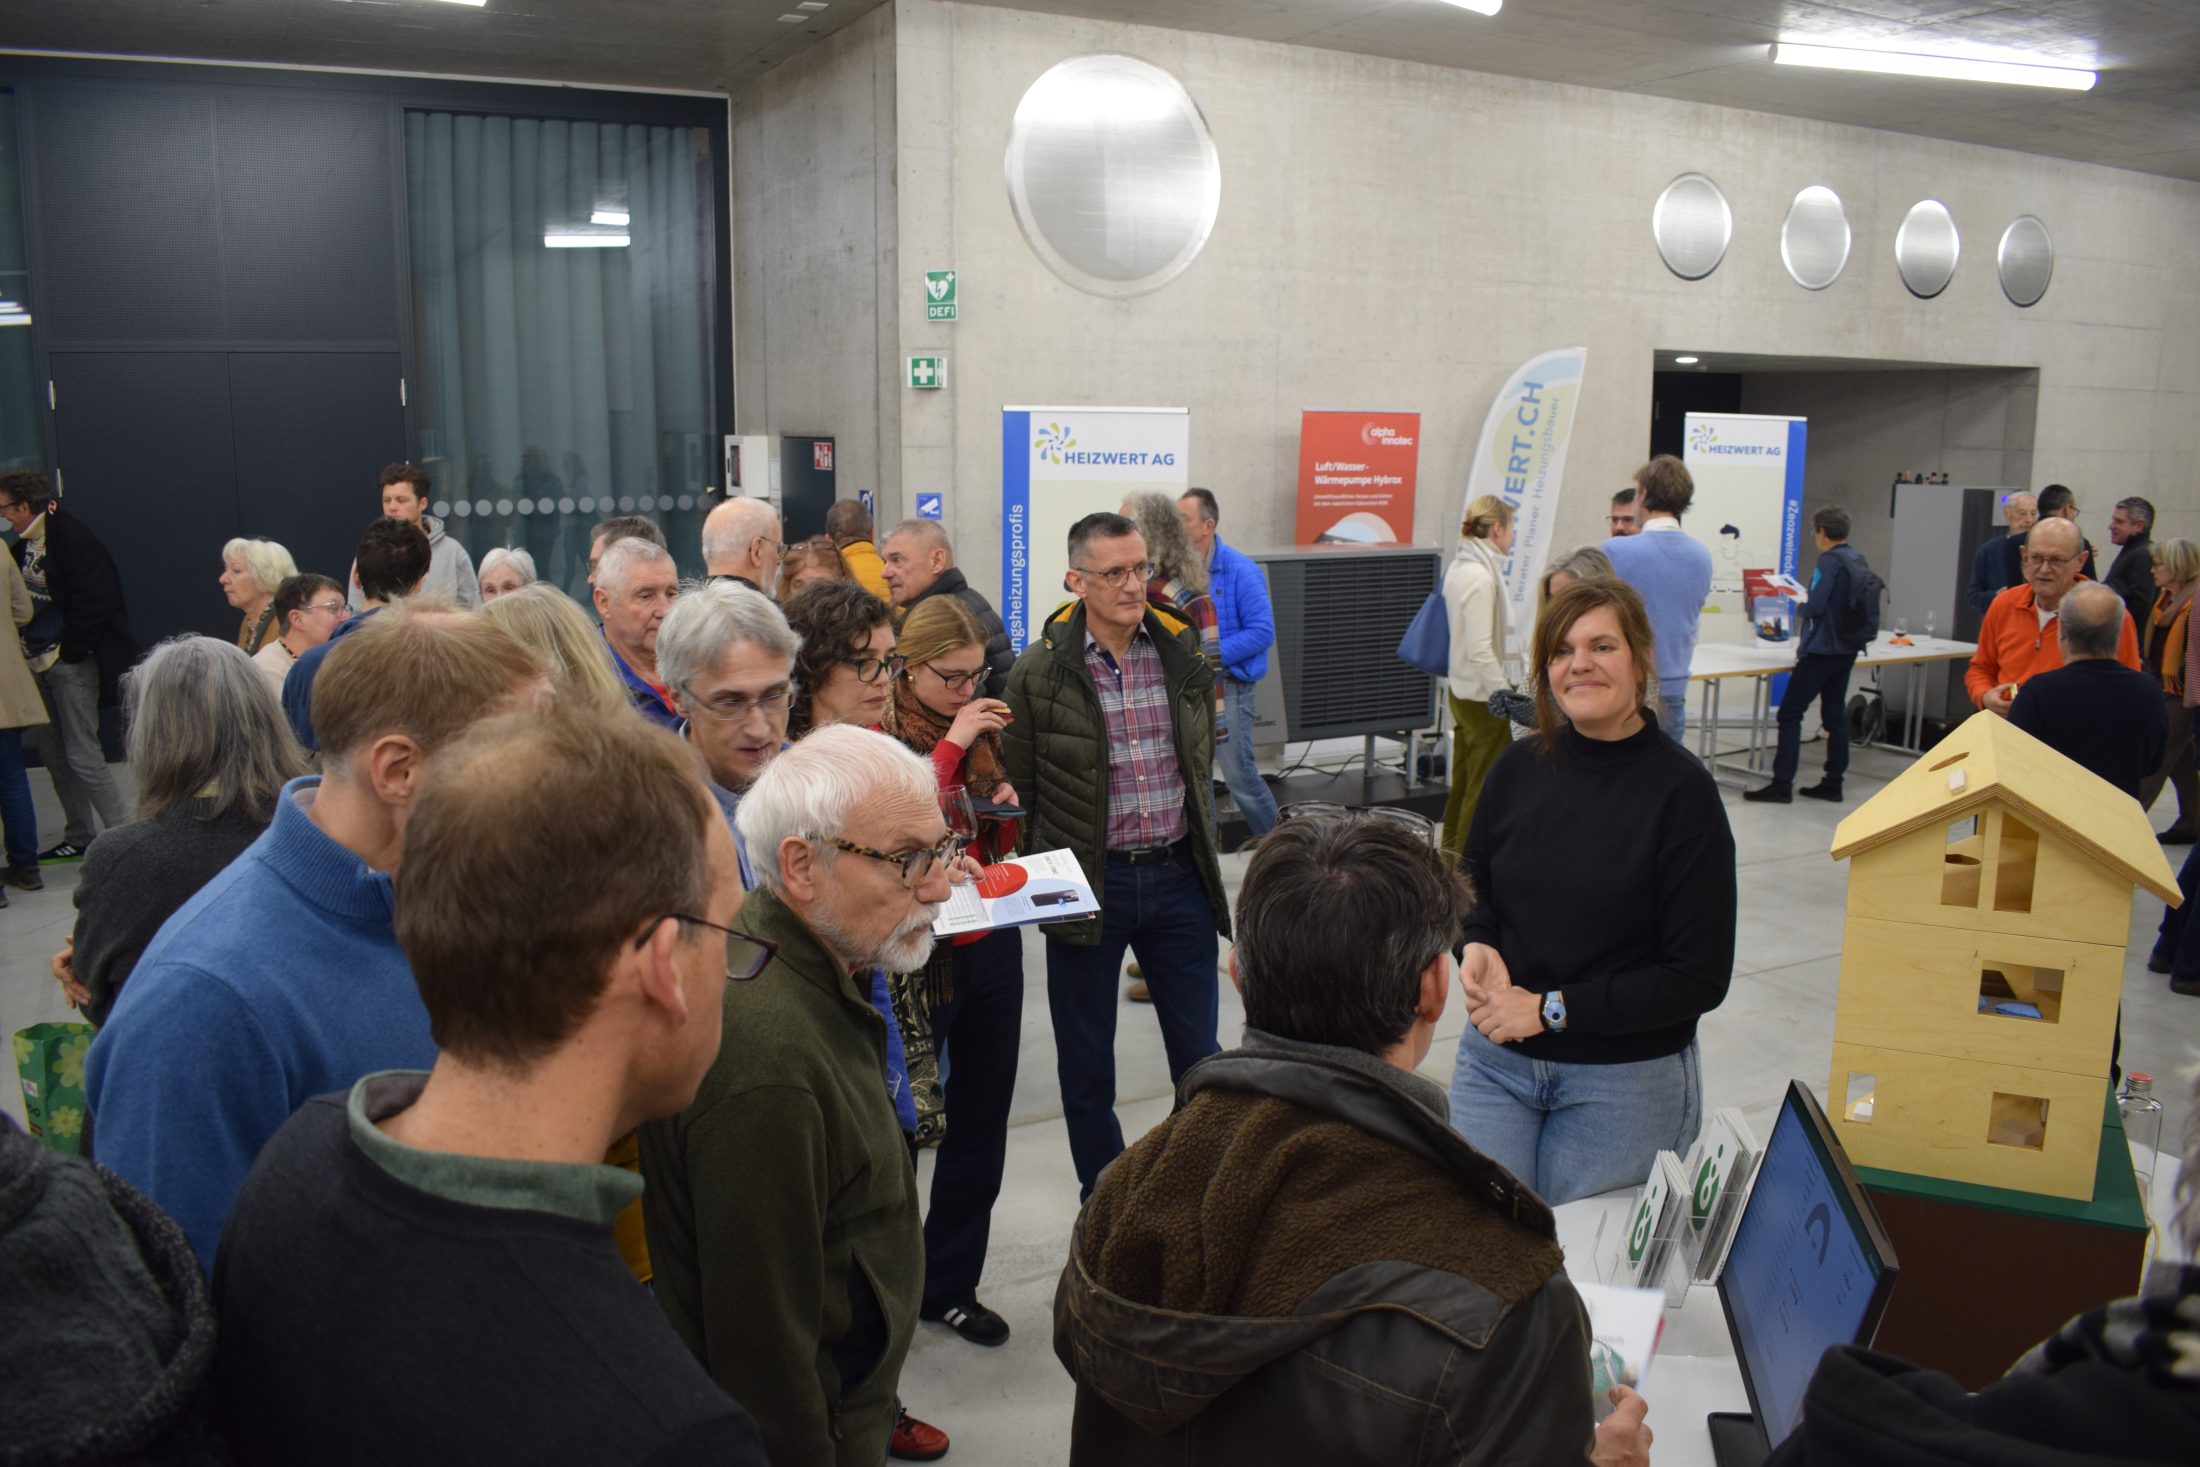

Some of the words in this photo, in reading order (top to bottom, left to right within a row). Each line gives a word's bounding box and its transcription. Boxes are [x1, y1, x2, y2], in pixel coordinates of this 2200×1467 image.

[929, 306, 955, 318] DEFI
[1371, 427, 1395, 438] alpha
[1709, 445, 1763, 456] HEIZWERT
[1766, 446, 1781, 456] AG
[1064, 452, 1148, 465] HEIZWERT
[1152, 453, 1175, 466] AG
[1314, 475, 1372, 487] Wärmepumpe
[1514, 551, 1531, 602] Berater
[1523, 506, 1540, 547] Planer
[1534, 398, 1559, 509] Heizungsbauer
[1009, 504, 1026, 657] ungsheizungsprofis
